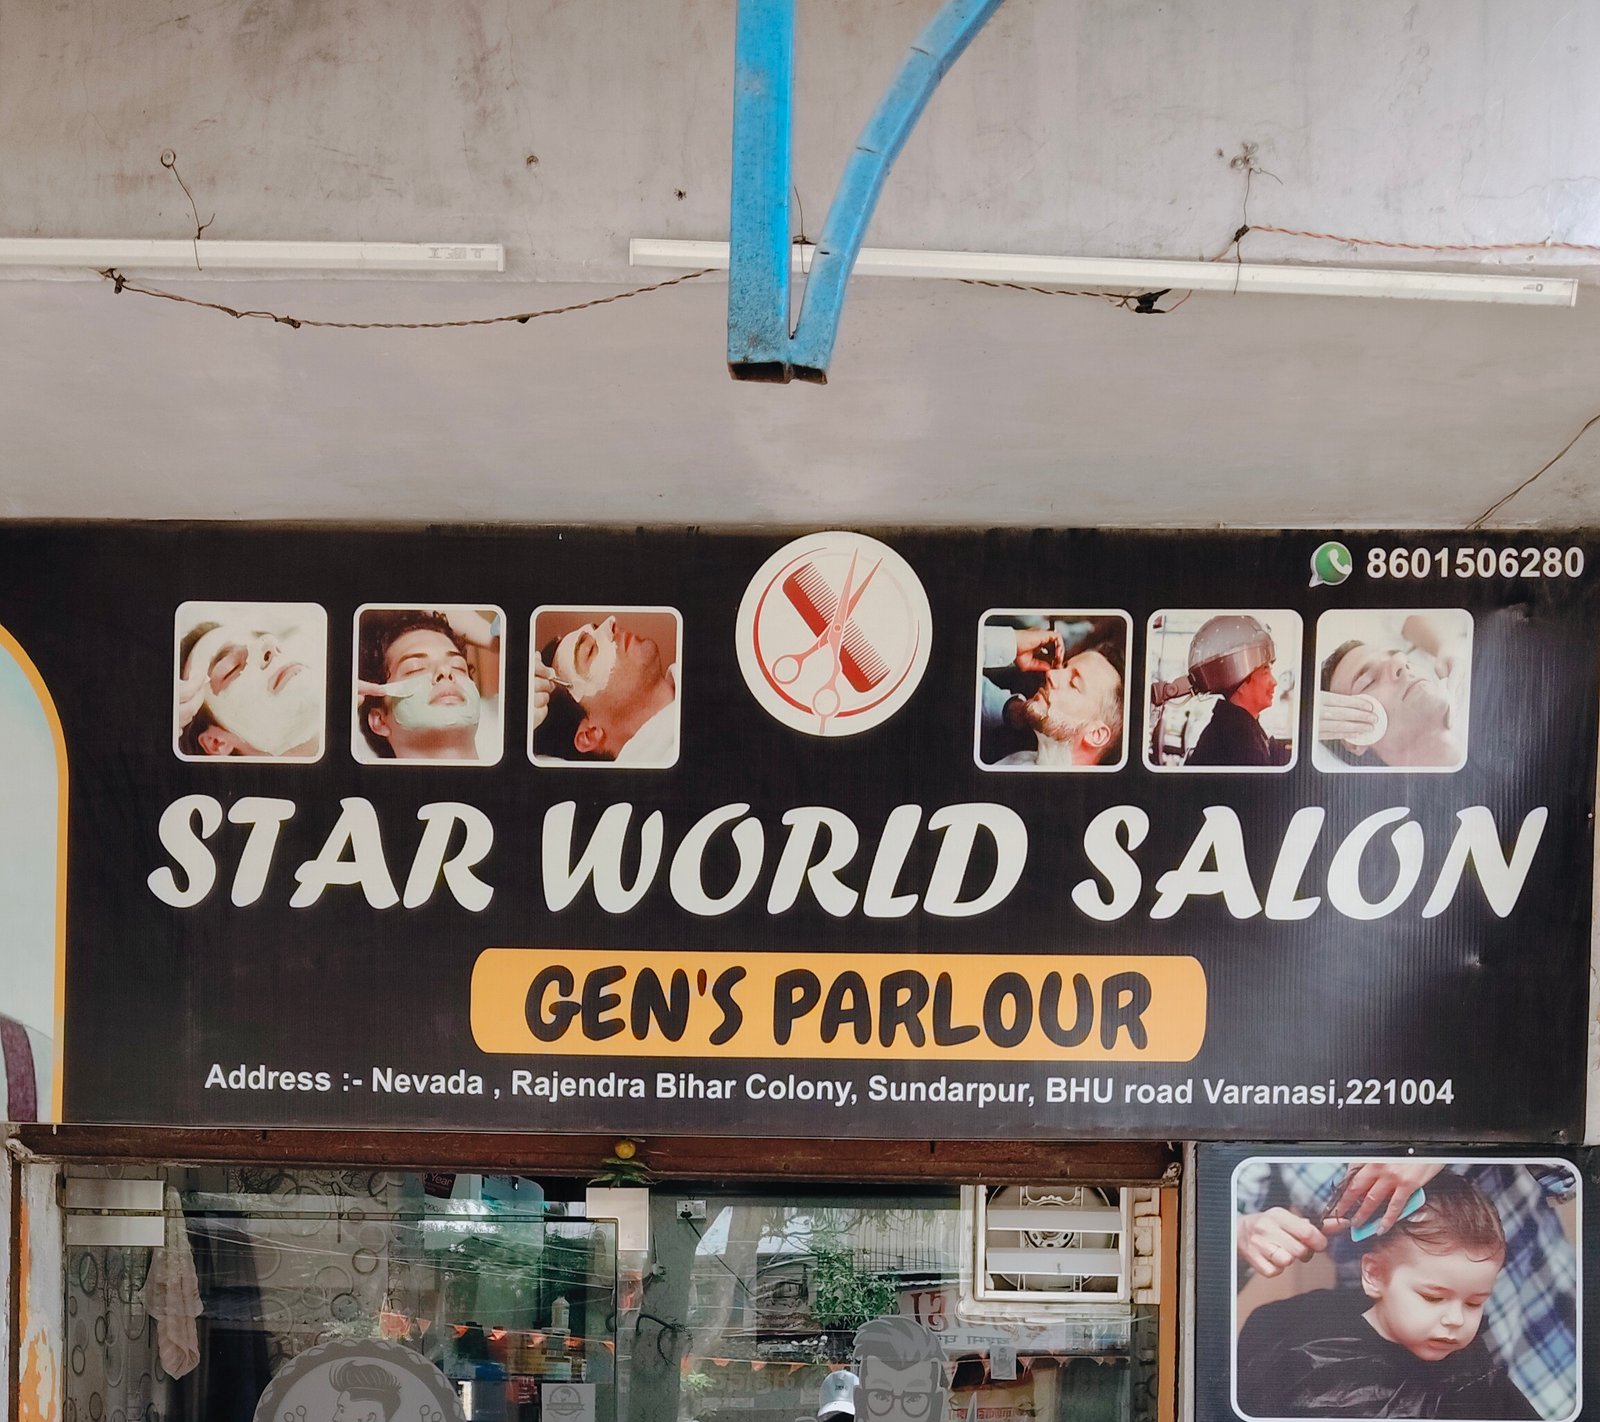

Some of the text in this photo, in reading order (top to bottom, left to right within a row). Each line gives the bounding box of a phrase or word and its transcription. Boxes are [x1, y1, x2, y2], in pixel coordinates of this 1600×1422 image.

[1366, 546, 1585, 579] 8601506280
[147, 794, 1549, 922] STAR WORLD SALON
[525, 964, 1152, 1051] GEN'S PARLOUR
[204, 1063, 332, 1092] Address
[372, 1067, 483, 1095] Nevada
[511, 1069, 646, 1103] Rajendra
[656, 1072, 737, 1099] Bihar
[745, 1073, 857, 1107] Colony,
[868, 1074, 1035, 1109] Sundarpur,
[1046, 1077, 1114, 1104] BHU
[1124, 1078, 1194, 1105] road
[1202, 1078, 1455, 1110] Varanasi,221004
